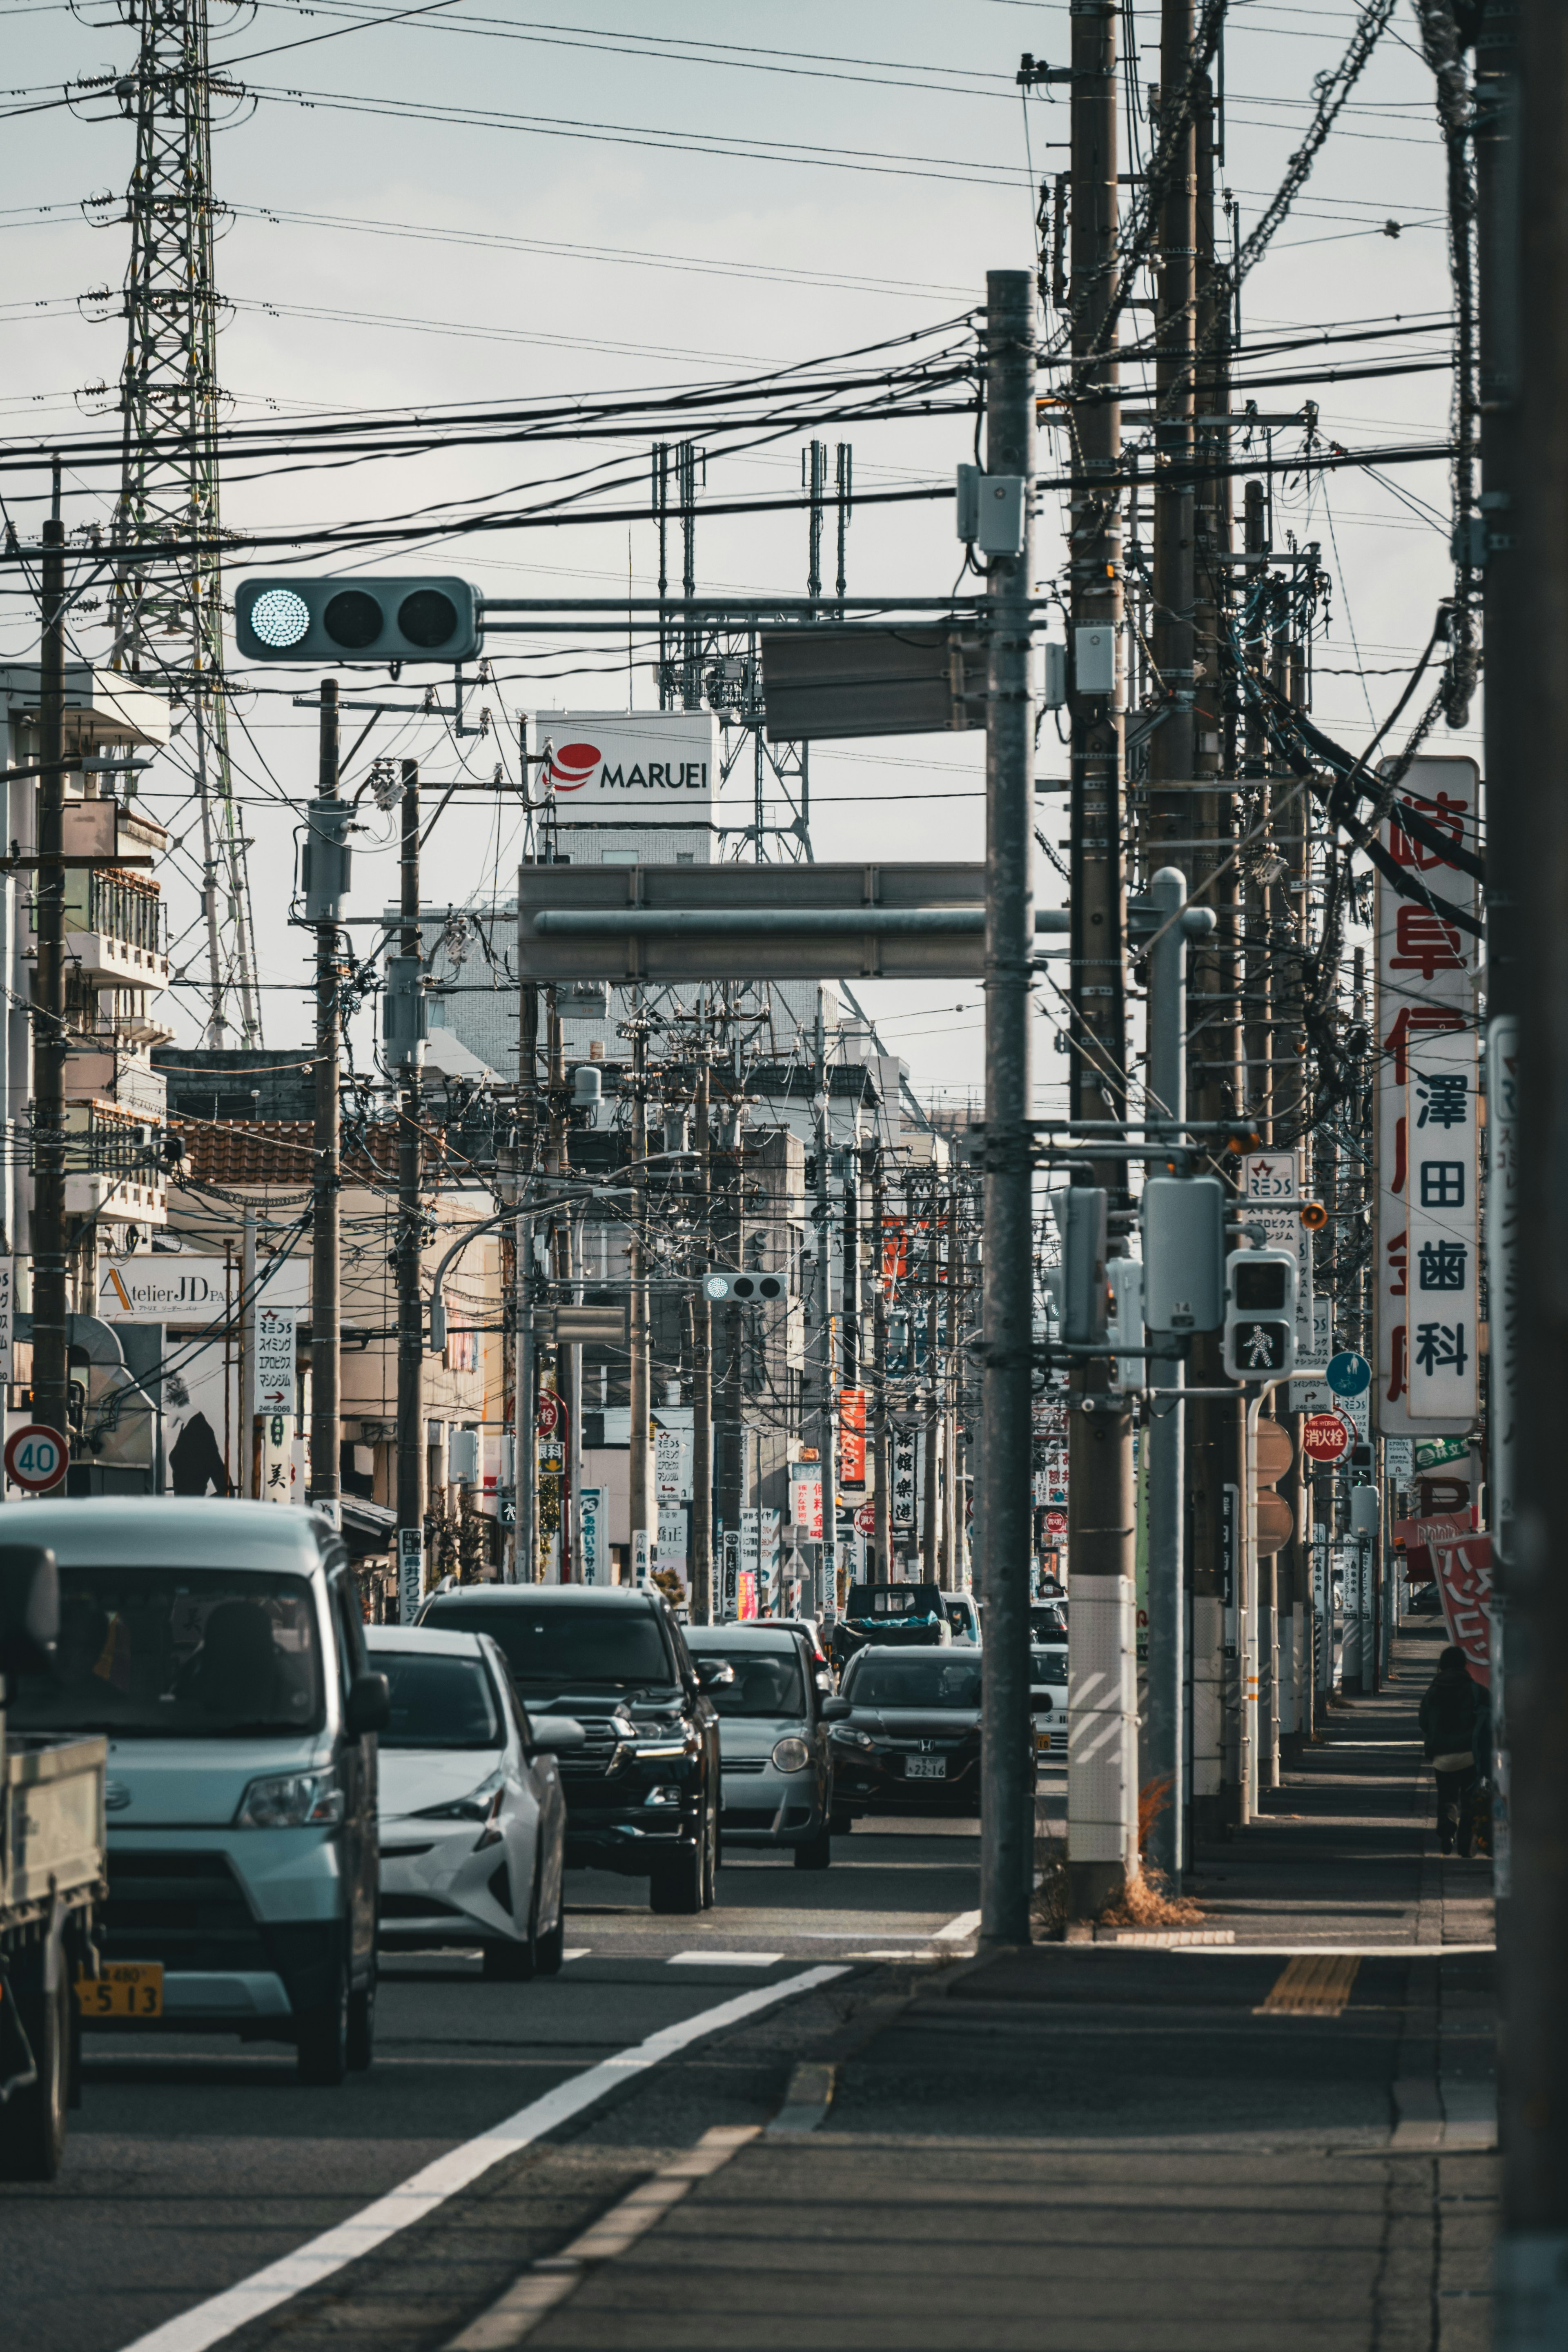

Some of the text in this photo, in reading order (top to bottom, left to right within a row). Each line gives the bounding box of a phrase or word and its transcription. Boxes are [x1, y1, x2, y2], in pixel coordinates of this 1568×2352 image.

[600, 763, 706, 788] MARUEI
[1251, 1178, 1292, 1196] REDS
[1416, 1074, 1468, 1377] 澤田歯科
[1267, 1232, 1294, 1240] ンジム
[100, 1268, 174, 1310] Atelier
[174, 1276, 208, 1301] JD
[1176, 1302, 1190, 1313] 14
[260, 1322, 292, 1334] REDS
[259, 1338, 291, 1351] スイミング
[259, 1356, 291, 1369] エアロビクス
[260, 1374, 291, 1387] マシンジム
[1345, 1400, 1365, 1409] REDS
[658, 1440, 680, 1448] REDS
[1306, 1429, 1344, 1446] 消火栓
[19, 1443, 54, 1472] 40
[658, 1450, 679, 1459] スイミング
[657, 1461, 679, 1470] エアロビクス
[657, 1472, 679, 1482] マシンジム
[861, 1516, 875, 1525] 消火
[404, 1556, 421, 1622] 高井クリニッ
